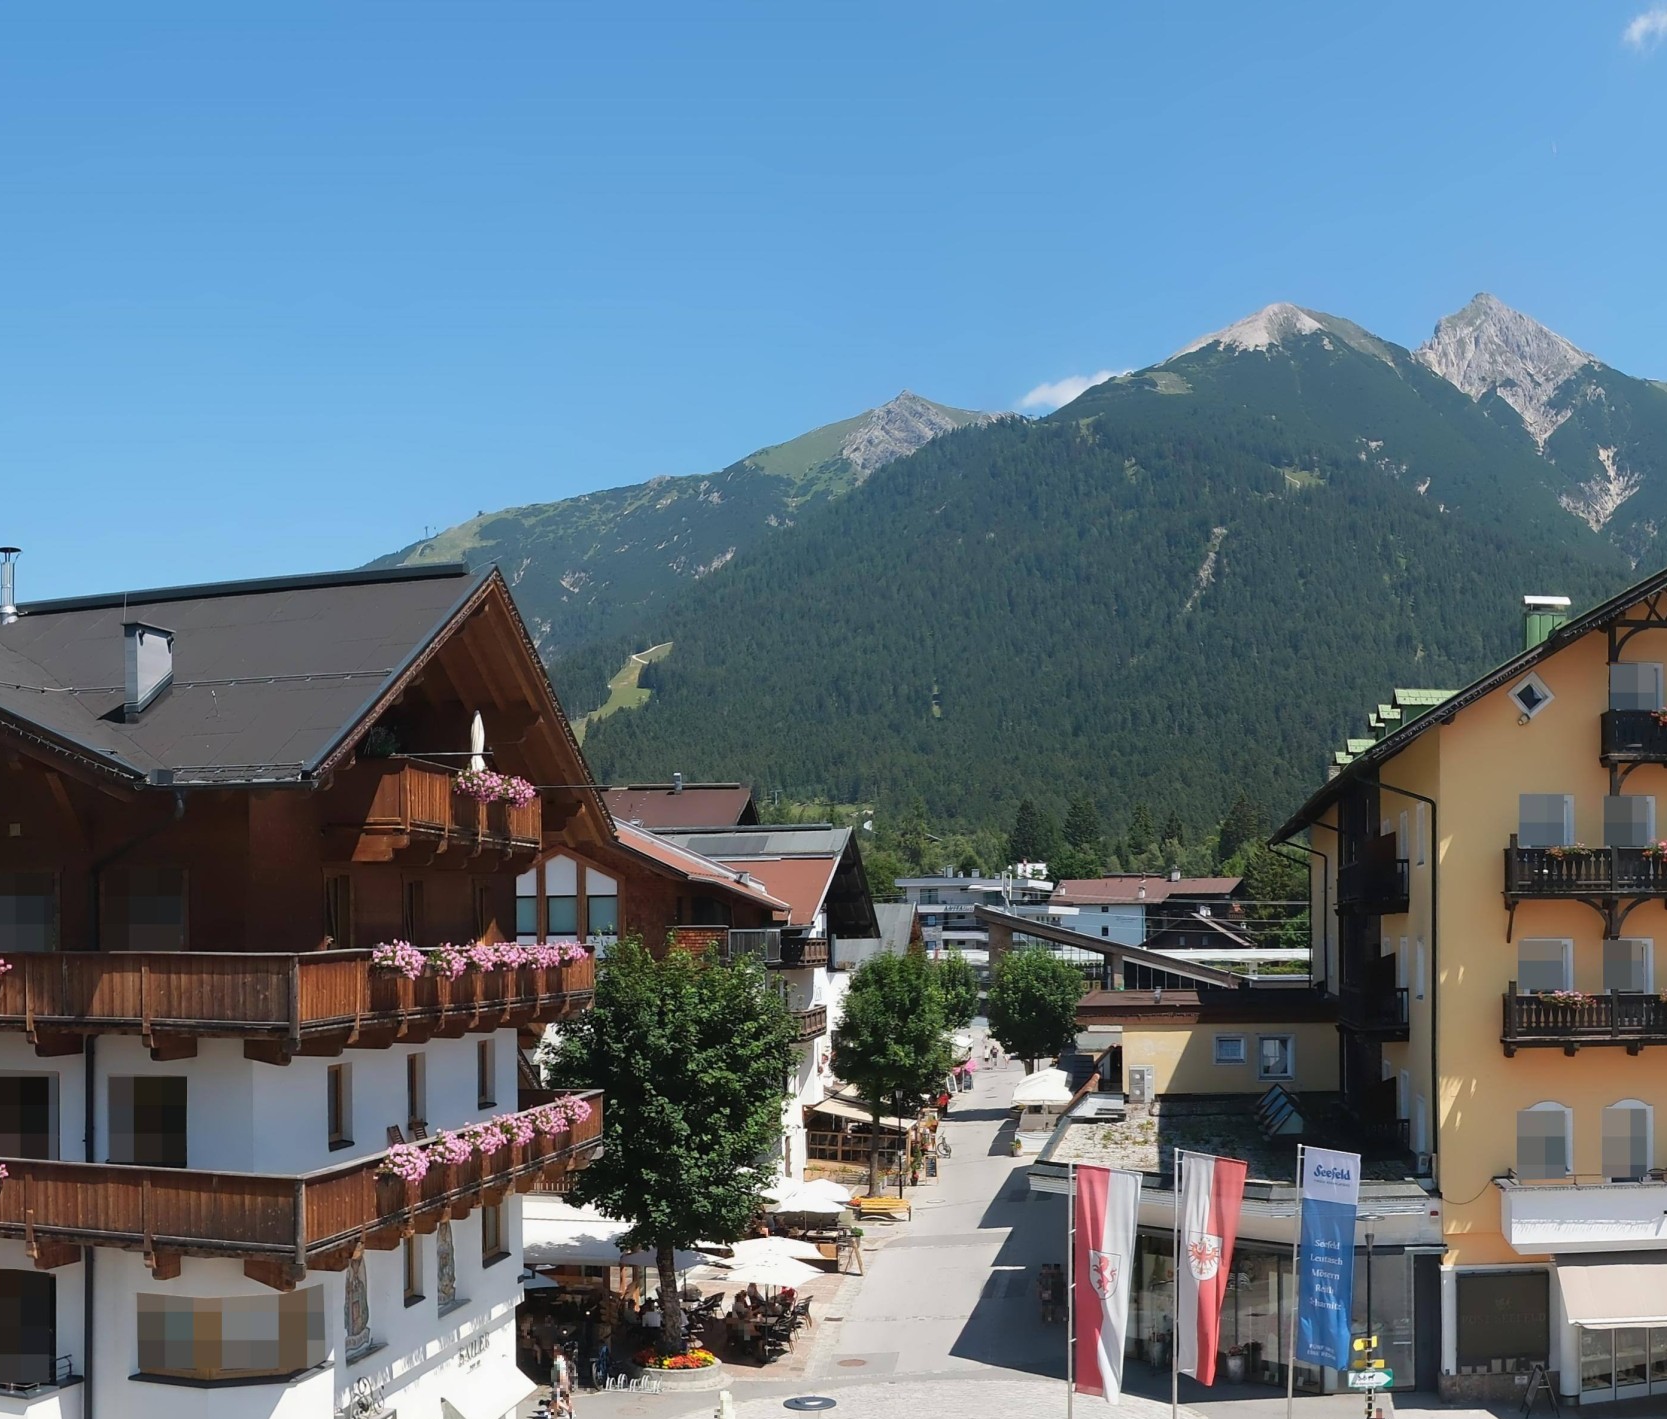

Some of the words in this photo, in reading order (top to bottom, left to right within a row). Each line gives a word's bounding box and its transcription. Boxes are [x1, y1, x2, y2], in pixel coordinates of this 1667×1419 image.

[1313, 1164, 1351, 1180] Seefeld
[1315, 1239, 1340, 1250] Seefeld
[1310, 1253, 1343, 1266] Leutasch
[1311, 1268, 1340, 1280] Mösern
